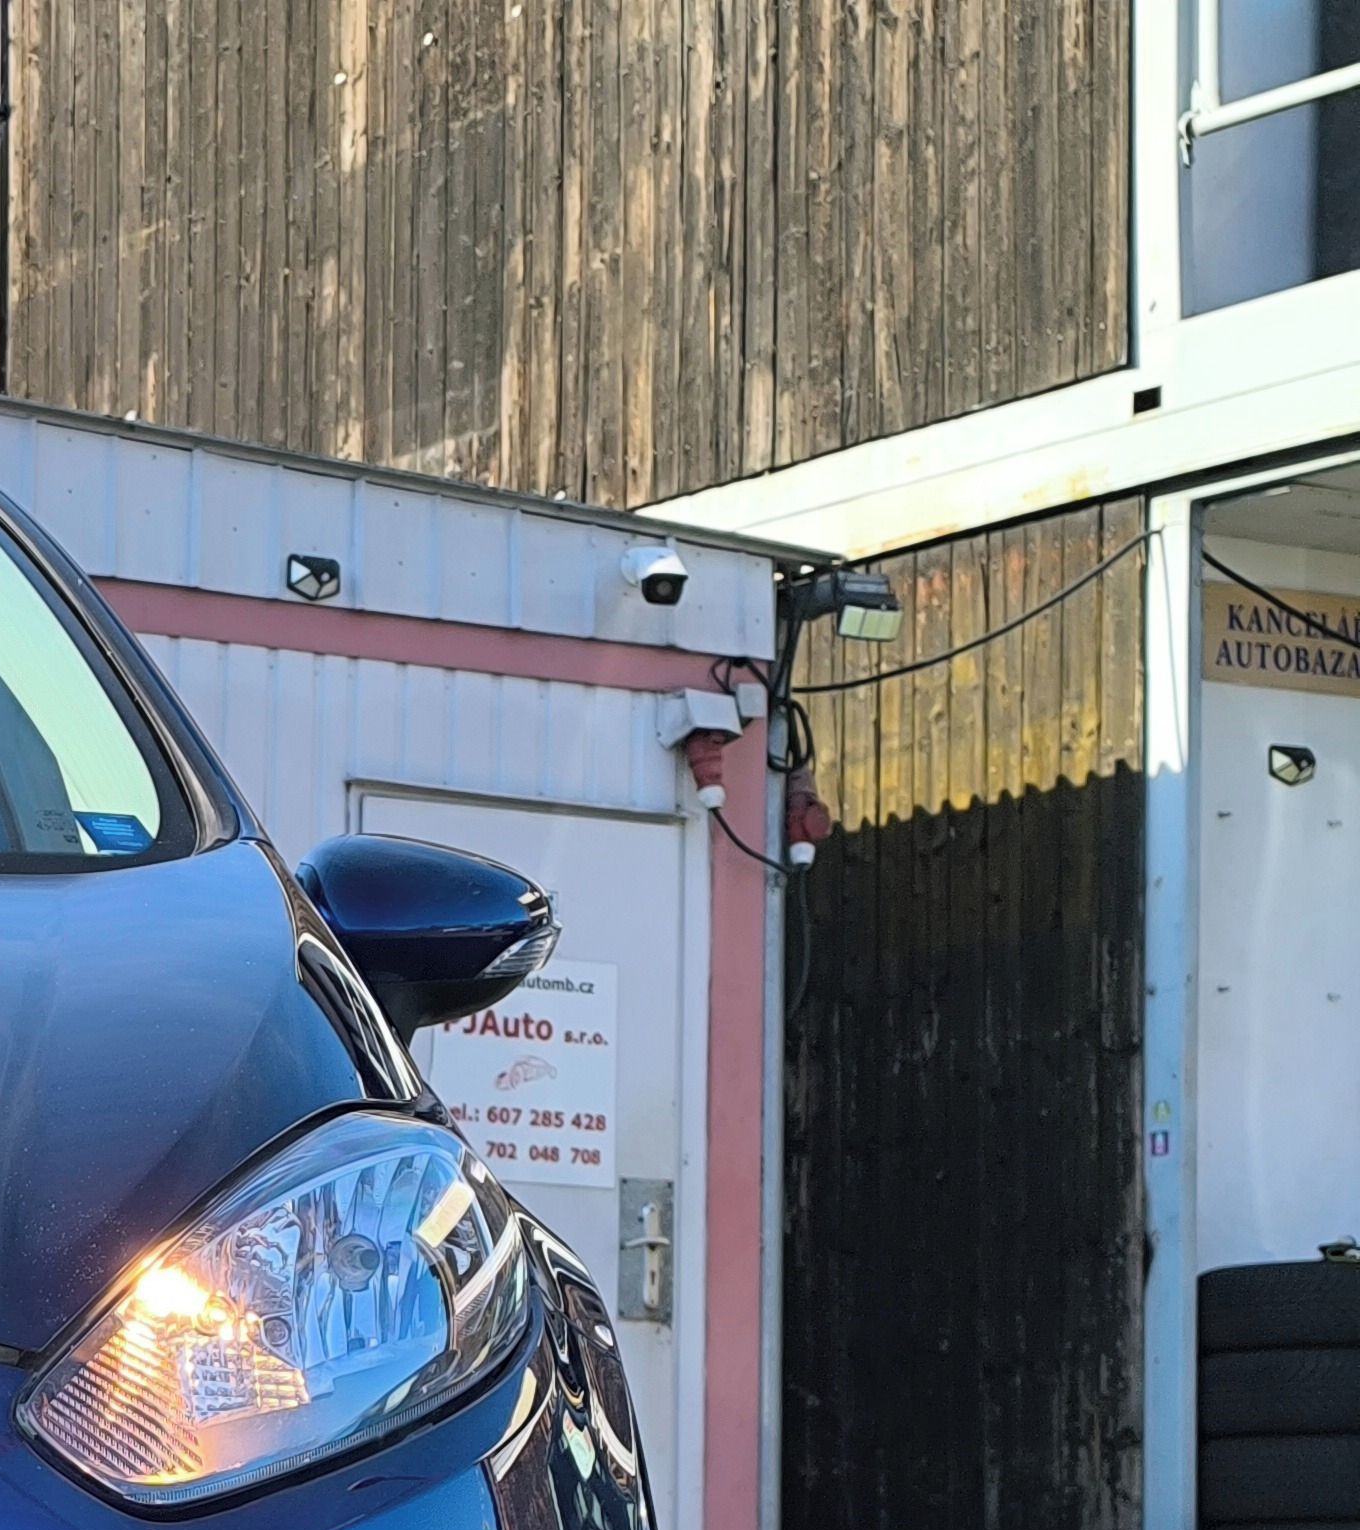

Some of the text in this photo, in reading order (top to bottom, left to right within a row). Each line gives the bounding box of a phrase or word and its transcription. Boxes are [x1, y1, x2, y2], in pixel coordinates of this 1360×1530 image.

[564, 1030, 609, 1046] s.r.o.
[449, 1102, 607, 1132] el.: 607 285 428
[485, 1141, 601, 1166] 702 048 708
